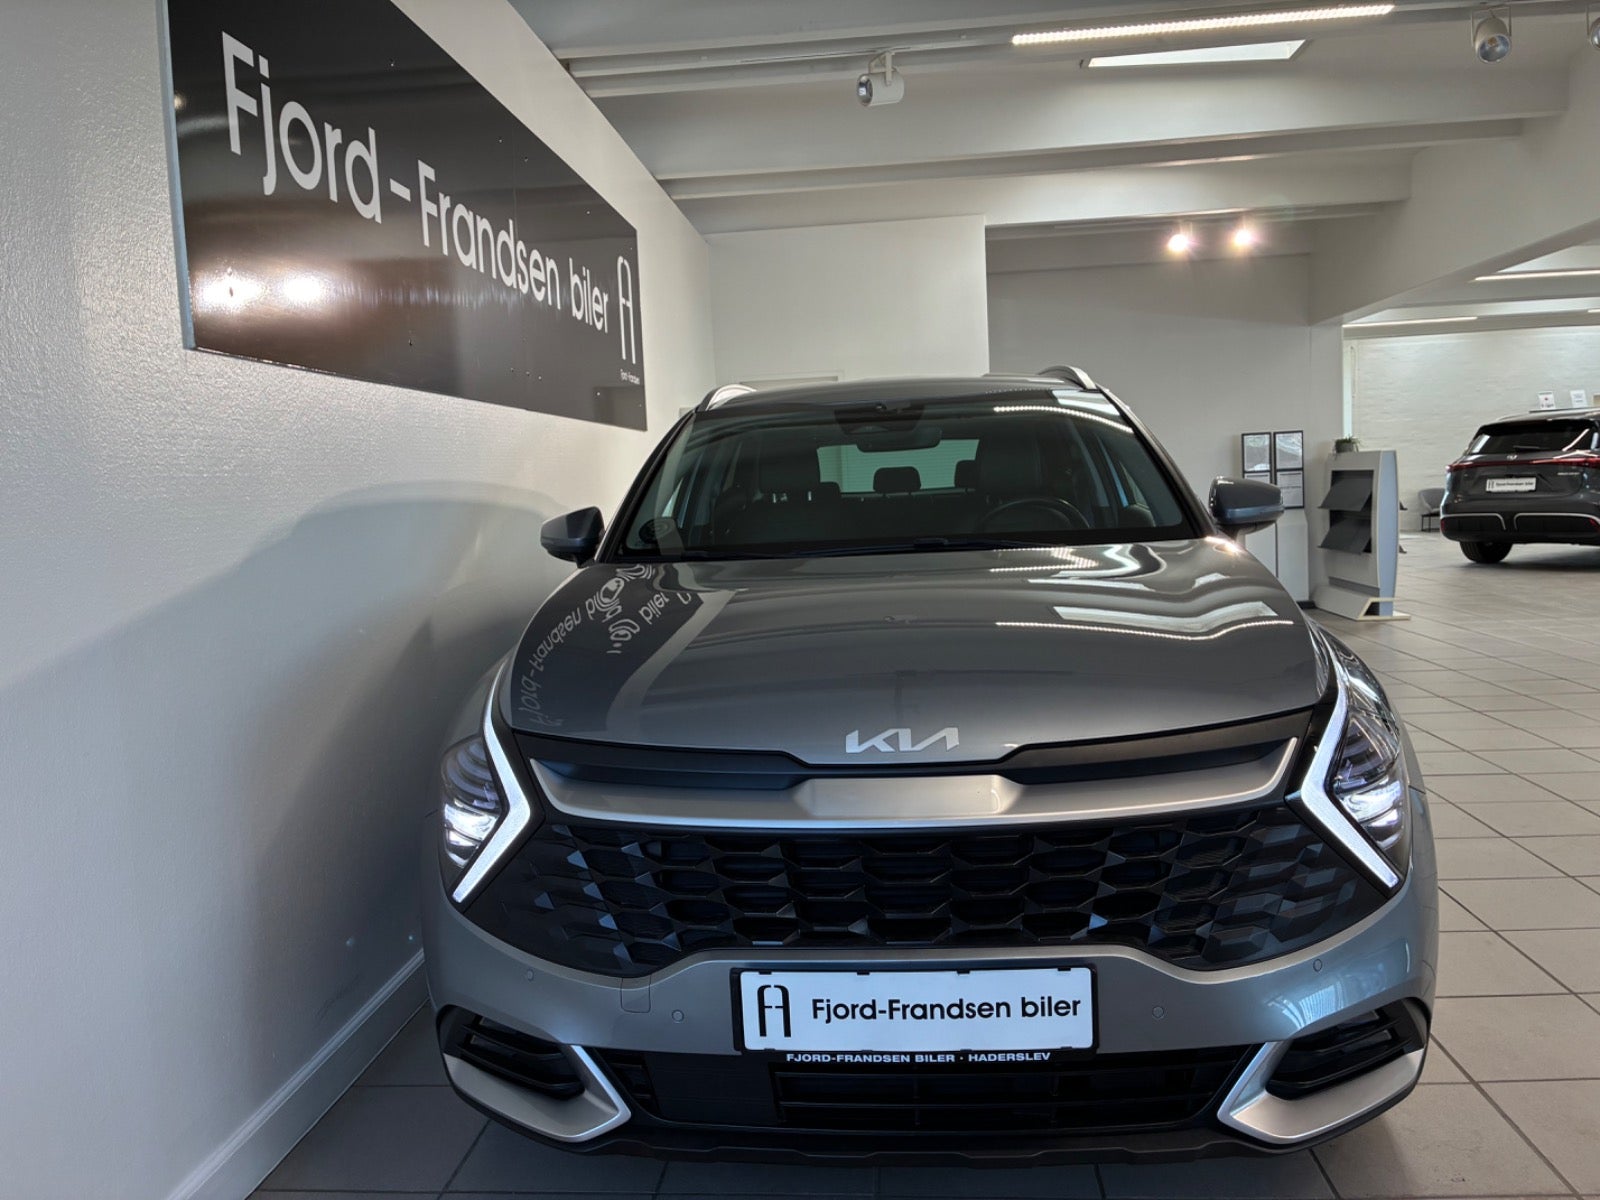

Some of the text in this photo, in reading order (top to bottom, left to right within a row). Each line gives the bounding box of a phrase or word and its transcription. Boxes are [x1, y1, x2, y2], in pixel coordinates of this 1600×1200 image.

[221, 31, 609, 334] Fjord-Frandsen biler
[845, 726, 960, 754] KIA
[811, 997, 1081, 1024] Fjord-Frandsen biler
[786, 1052, 1051, 1063] FJORD-FRANDSEN BILER HADERSLEV
